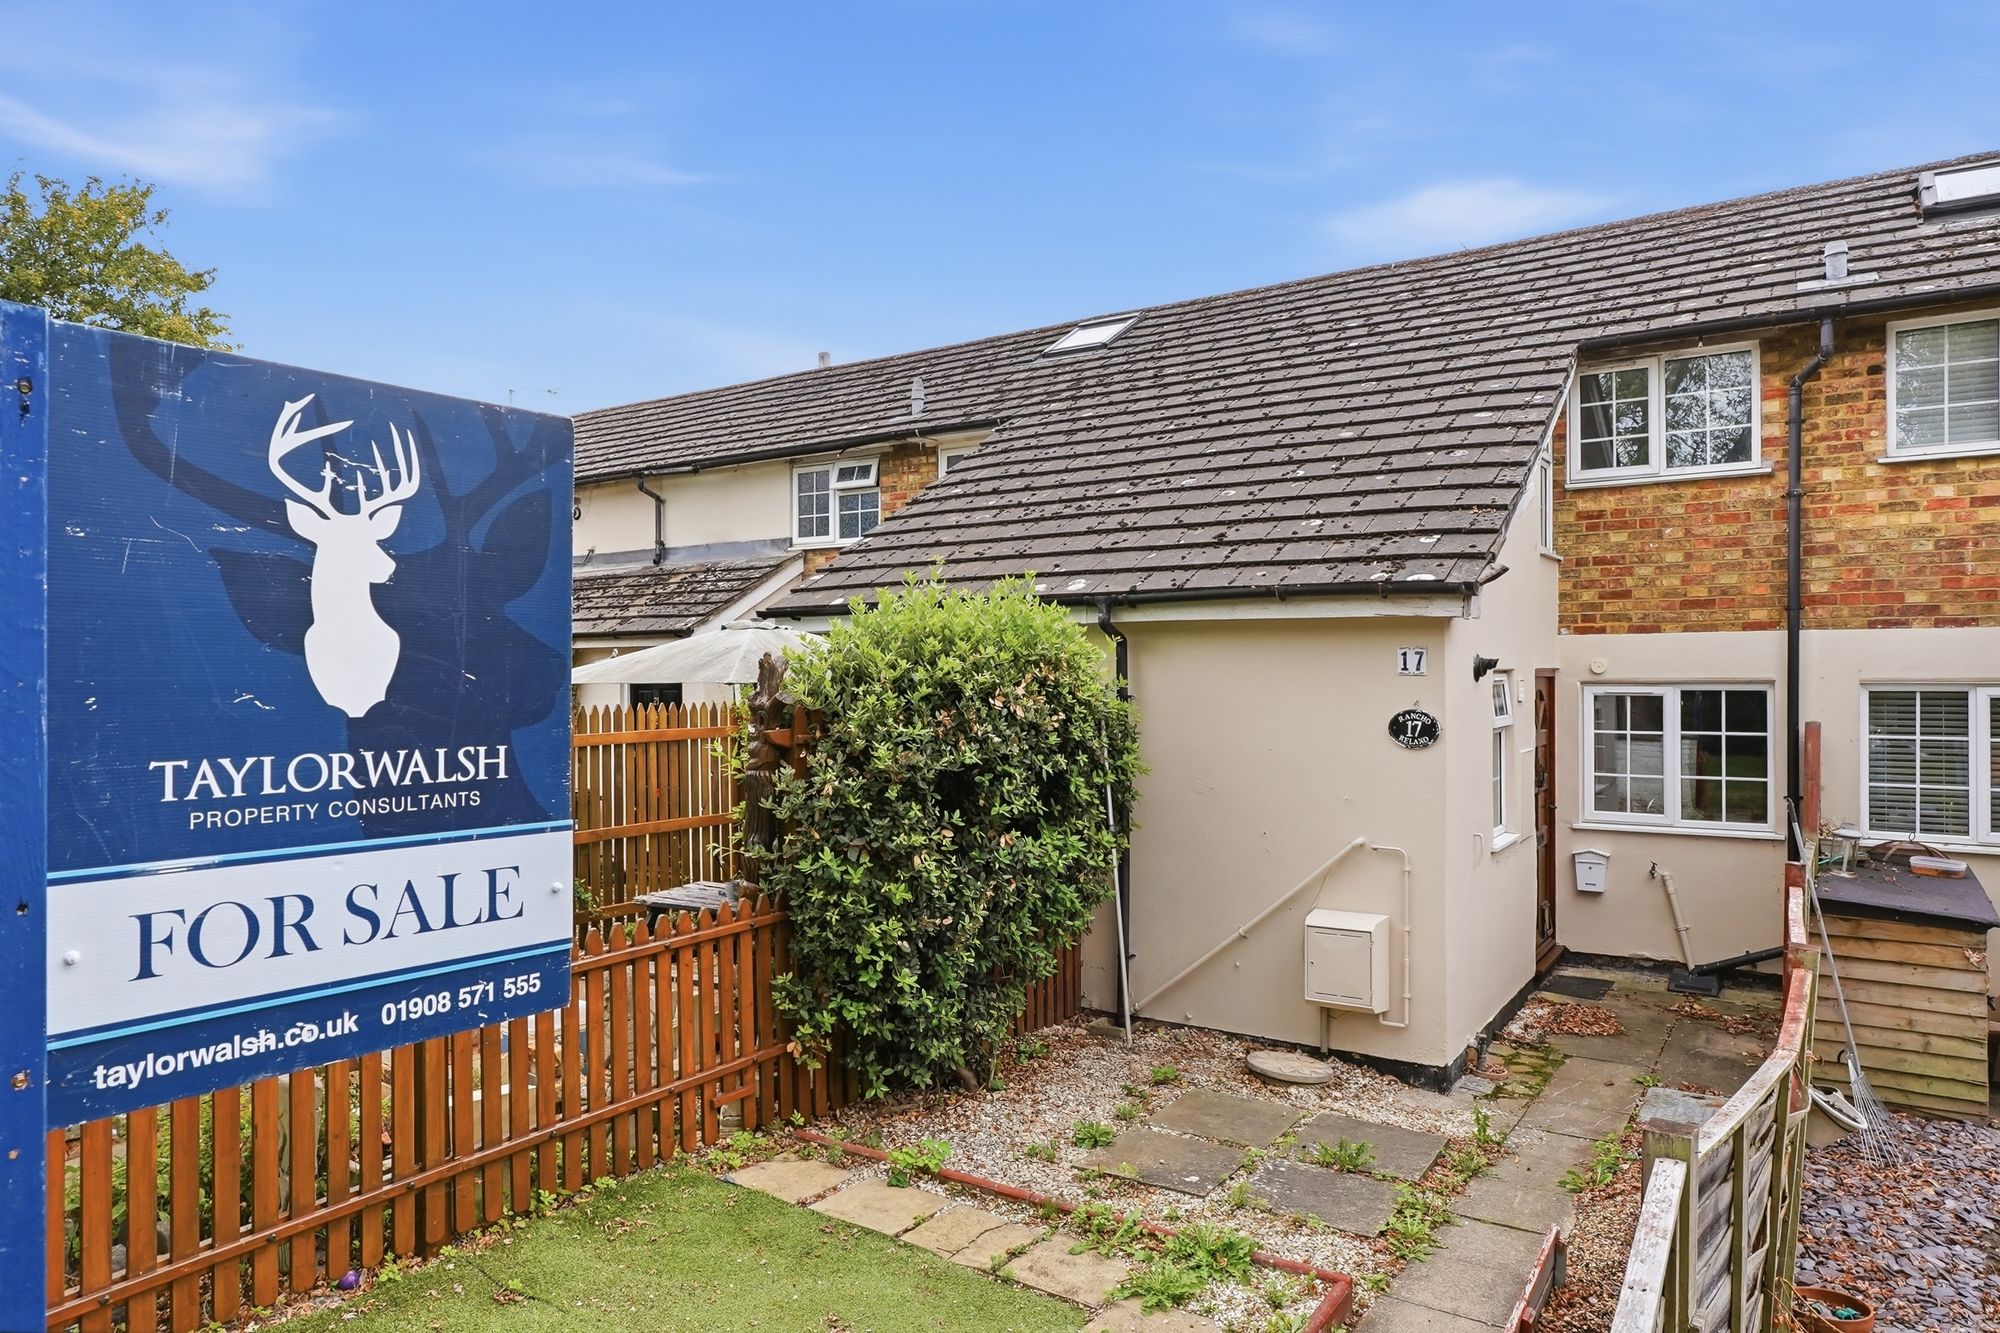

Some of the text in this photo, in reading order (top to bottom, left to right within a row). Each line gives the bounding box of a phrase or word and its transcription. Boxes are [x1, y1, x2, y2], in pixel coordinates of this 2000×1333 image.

[1401, 651, 1424, 671] 17
[1398, 712, 1431, 725] RANCHO
[1406, 720, 1422, 737] 17
[189, 790, 481, 830] PROPERTY CONSULTANTS
[127, 866, 524, 982] FOR SALE
[94, 972, 541, 1091] taylorwalsh.co.uk 01908 571 555
